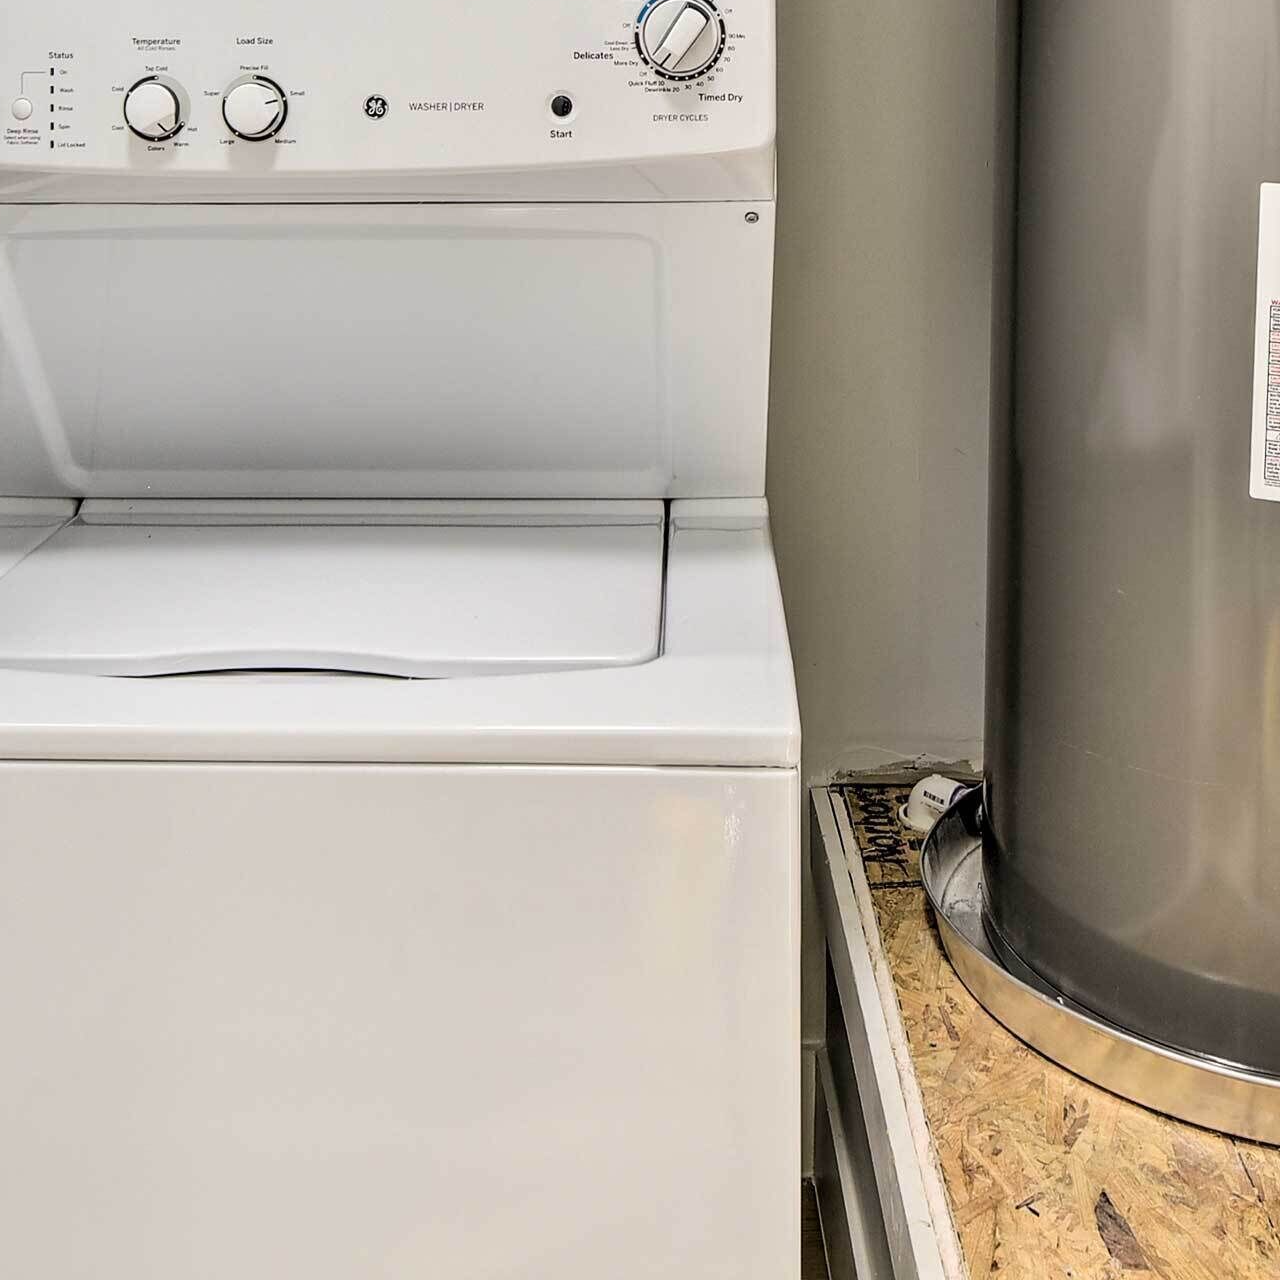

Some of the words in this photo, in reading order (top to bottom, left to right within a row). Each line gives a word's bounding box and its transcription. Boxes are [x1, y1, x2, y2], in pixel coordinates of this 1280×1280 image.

[133, 38, 181, 46] Temperature
[48, 52, 74, 60] Status
[573, 52, 614, 60] Delicates
[698, 94, 726, 102] Timed
[728, 94, 744, 102] Dry
[409, 102, 448, 111] WASHER
[454, 102, 484, 111] DRYER
[550, 130, 572, 138] Start
